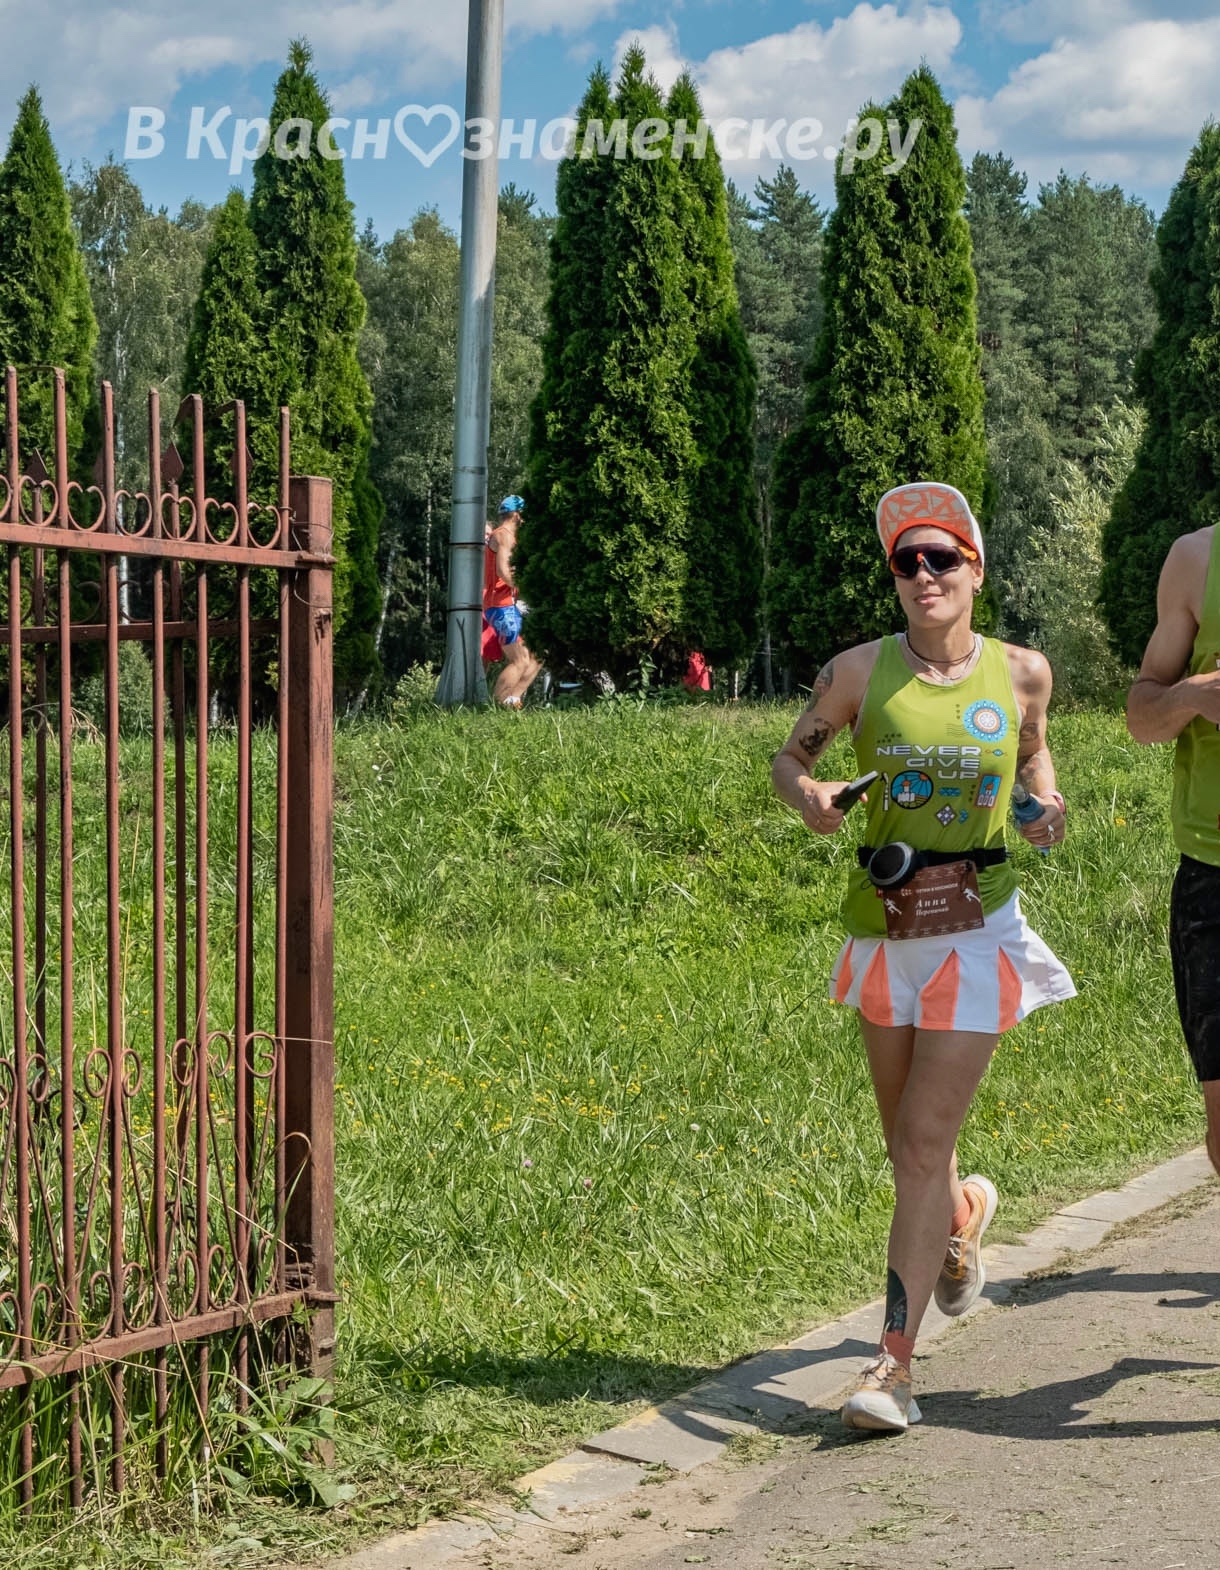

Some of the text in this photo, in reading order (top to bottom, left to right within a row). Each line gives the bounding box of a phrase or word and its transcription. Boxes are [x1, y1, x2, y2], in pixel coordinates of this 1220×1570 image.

[876, 744, 982, 757] NEVER
[906, 757, 980, 769] GIVE
[937, 770, 979, 780] UP
